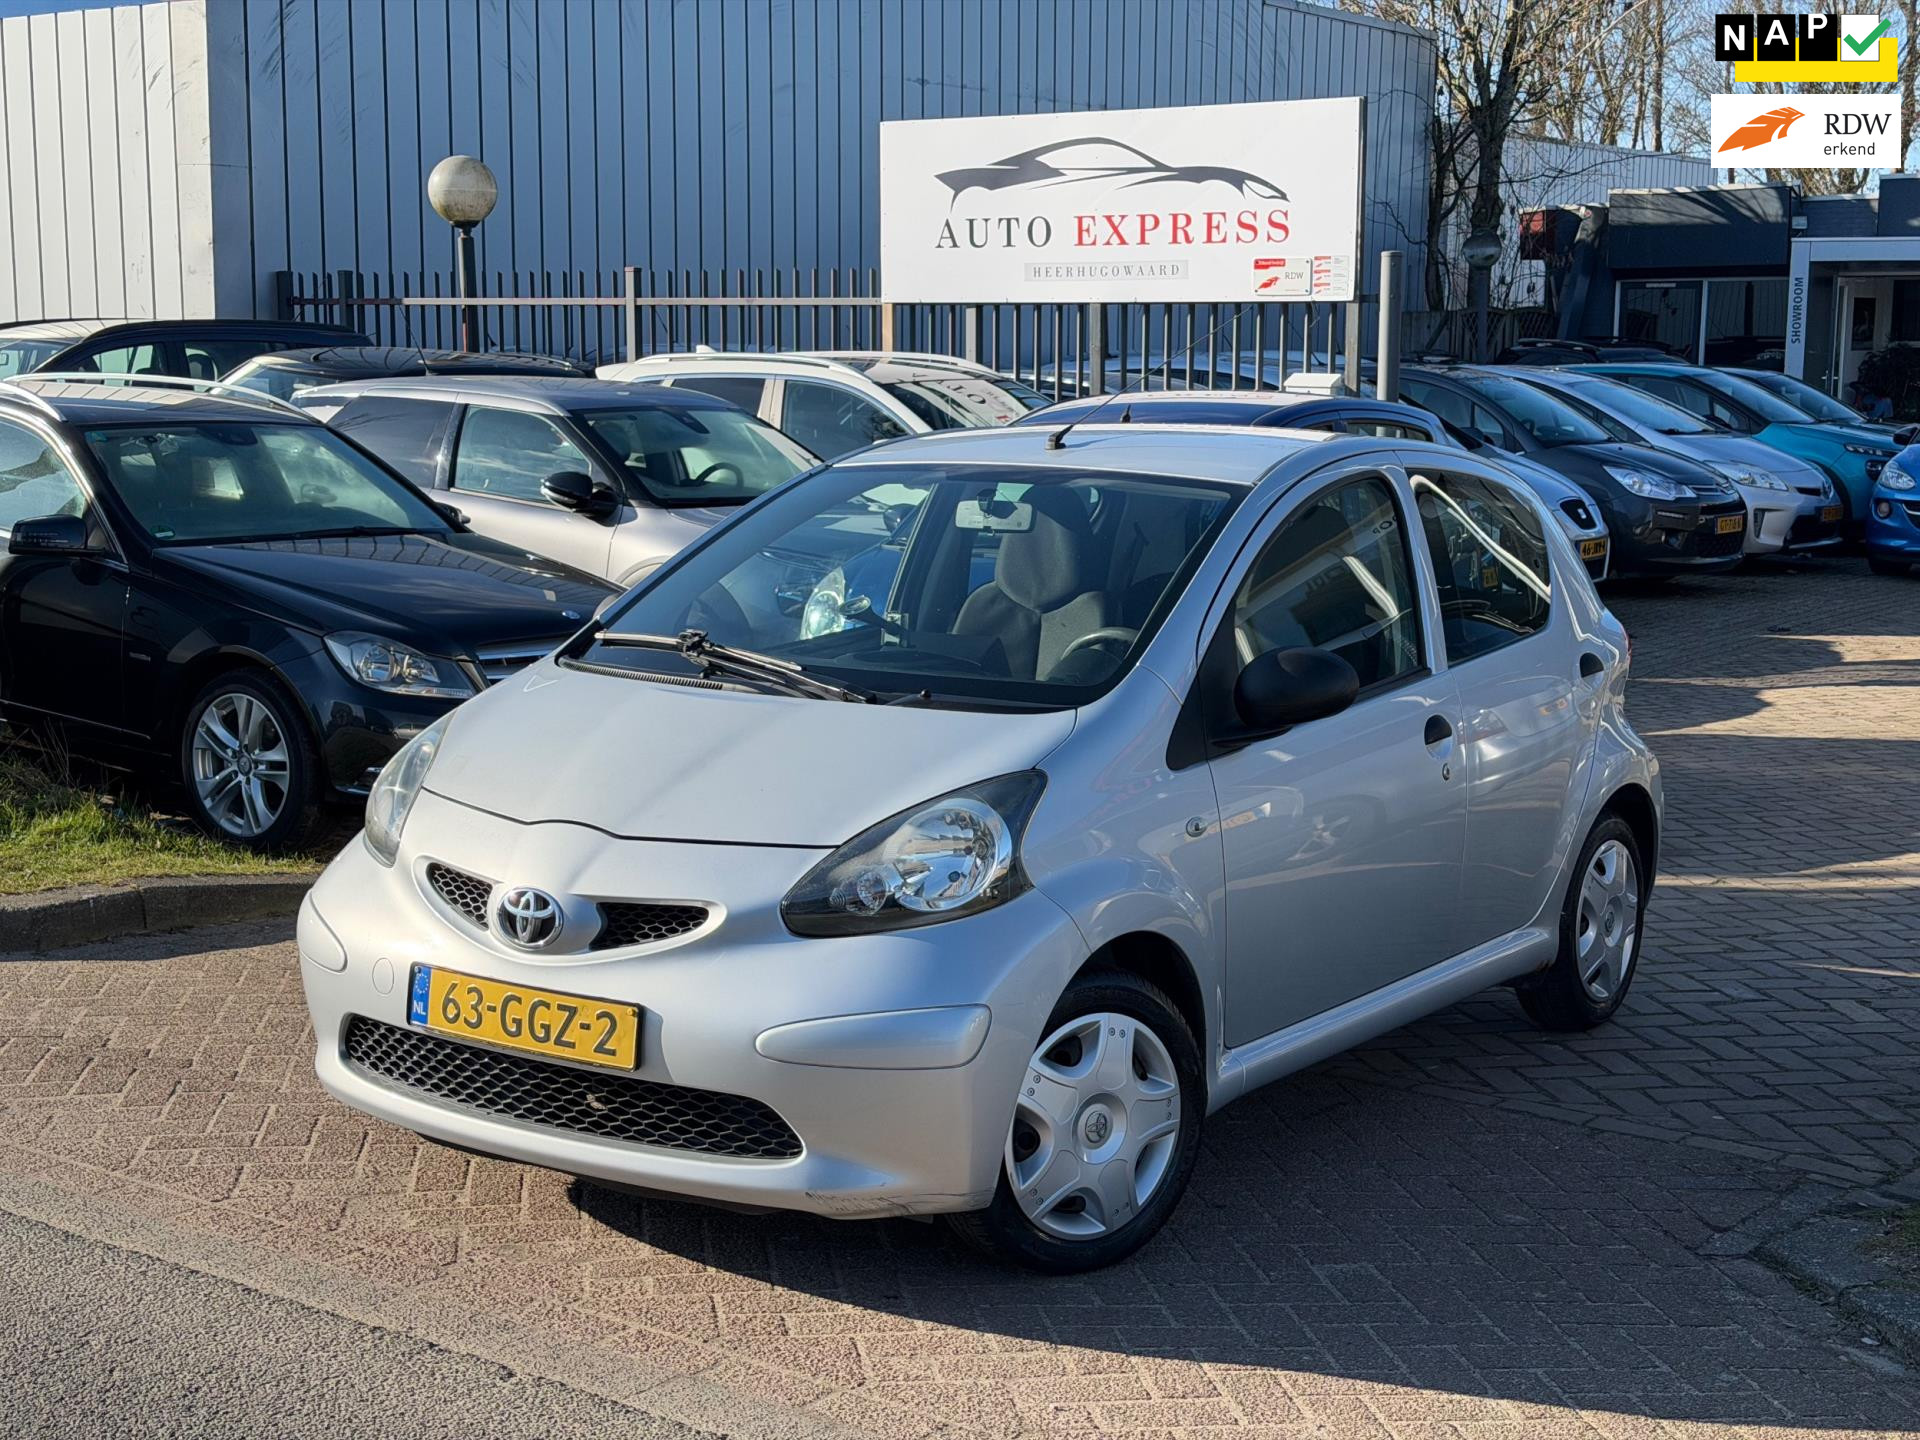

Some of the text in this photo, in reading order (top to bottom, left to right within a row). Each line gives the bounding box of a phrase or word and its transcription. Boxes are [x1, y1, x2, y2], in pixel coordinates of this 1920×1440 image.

[935, 209, 1290, 249] AUTO EXPRESS
[1032, 263, 1180, 279] HEERHUGOWAARD
[1790, 277, 1804, 344] SHOWROOM
[412, 1000, 427, 1016] NL
[441, 981, 618, 1057] 63-GGZ-2
